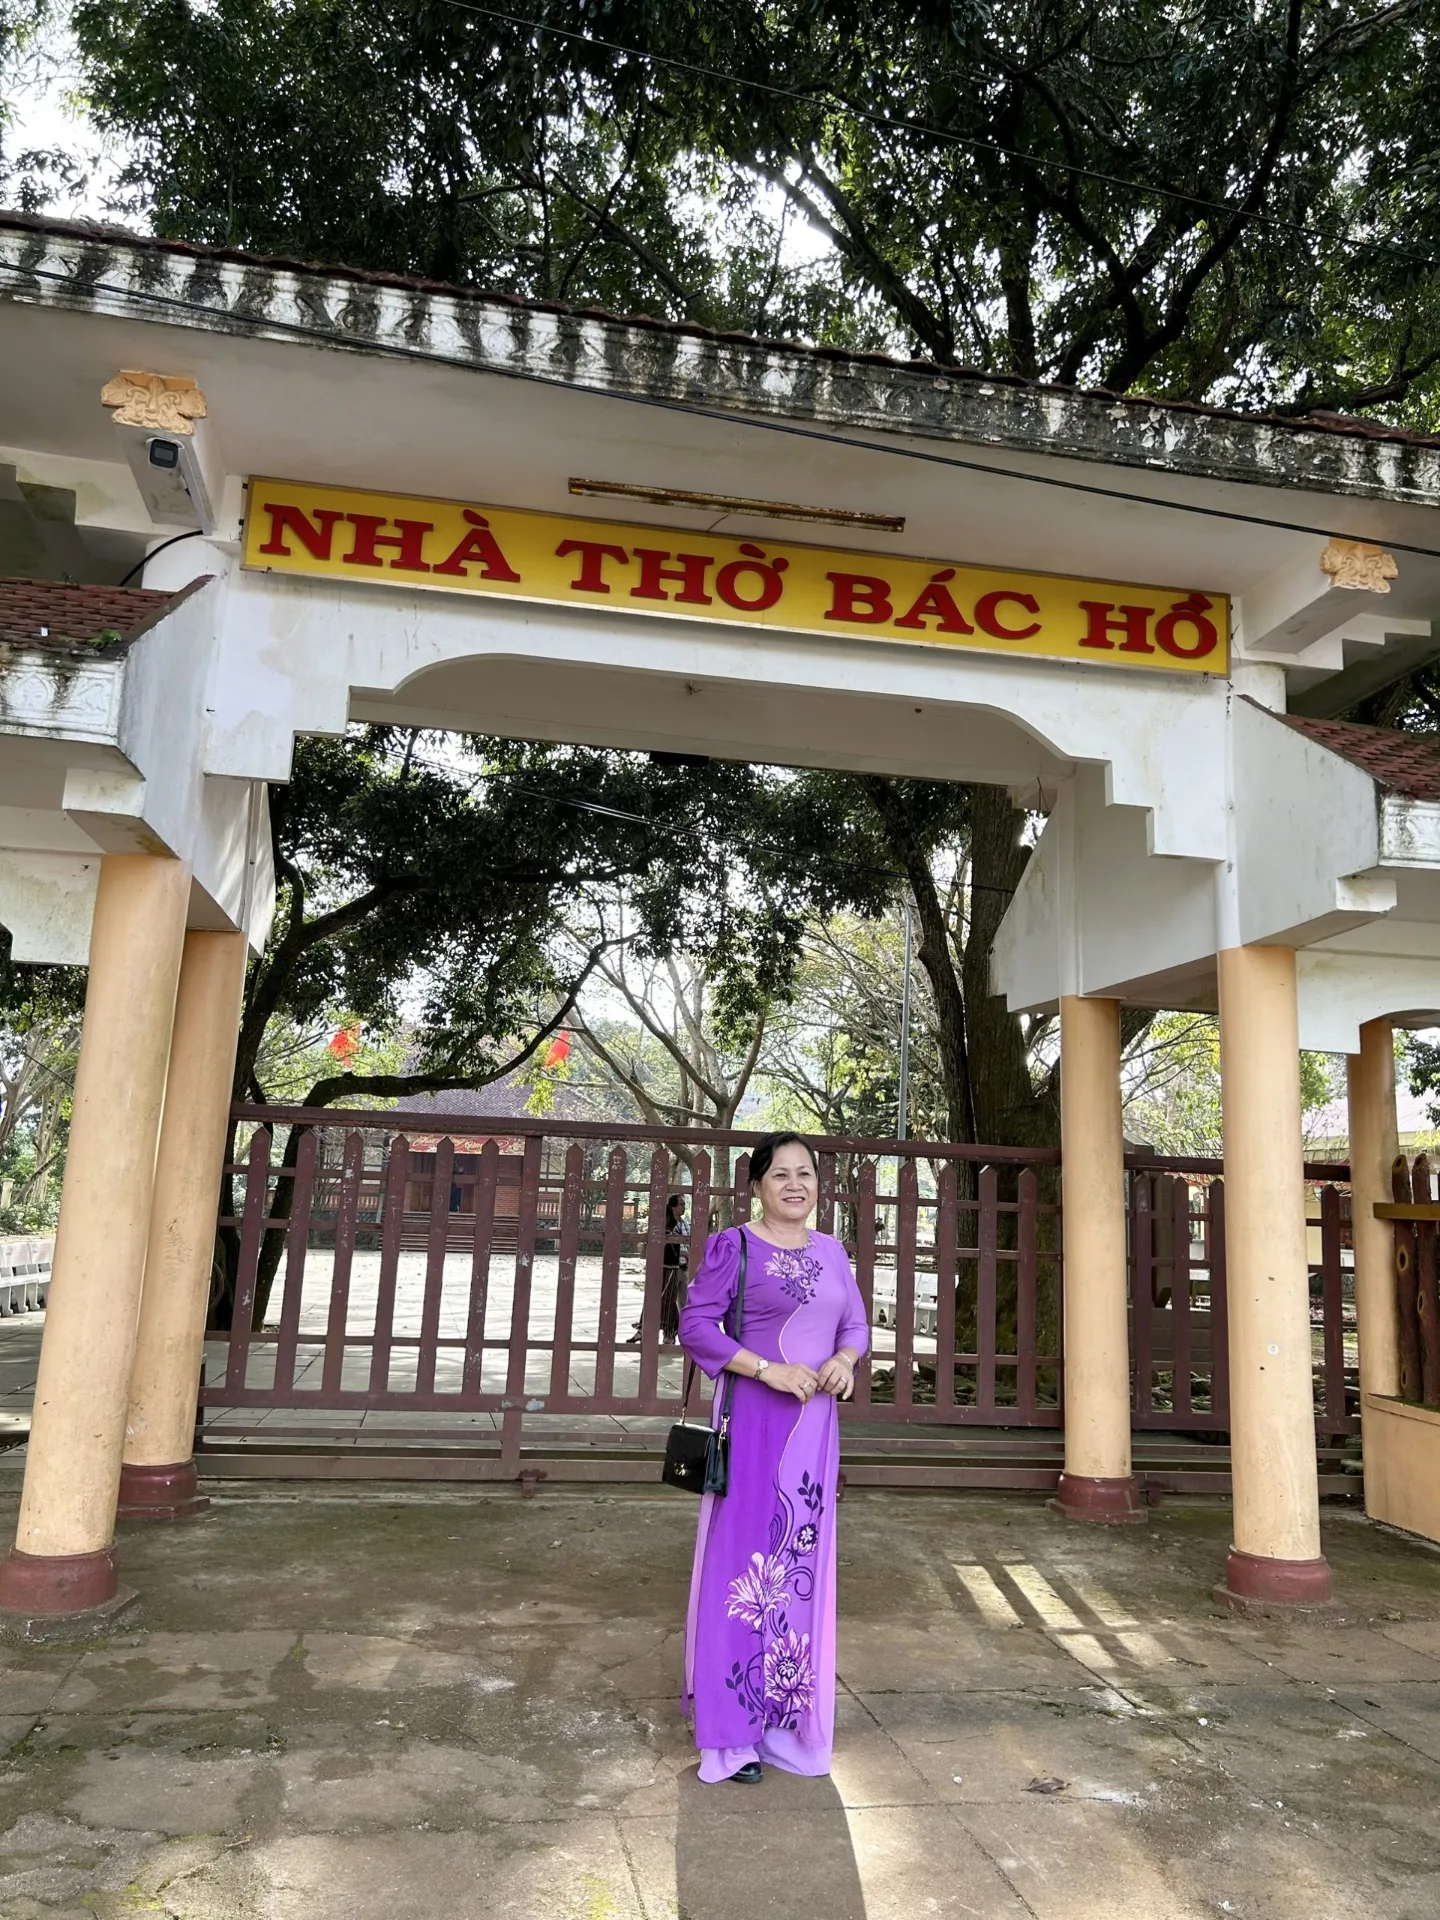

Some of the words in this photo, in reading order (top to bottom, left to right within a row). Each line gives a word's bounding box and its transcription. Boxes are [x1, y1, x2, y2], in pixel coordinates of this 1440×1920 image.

[260, 503, 520, 582] NHÀ
[555, 539, 789, 611] THỜ
[824, 568, 1042, 640] BÁC
[1078, 592, 1218, 659] HỒ
